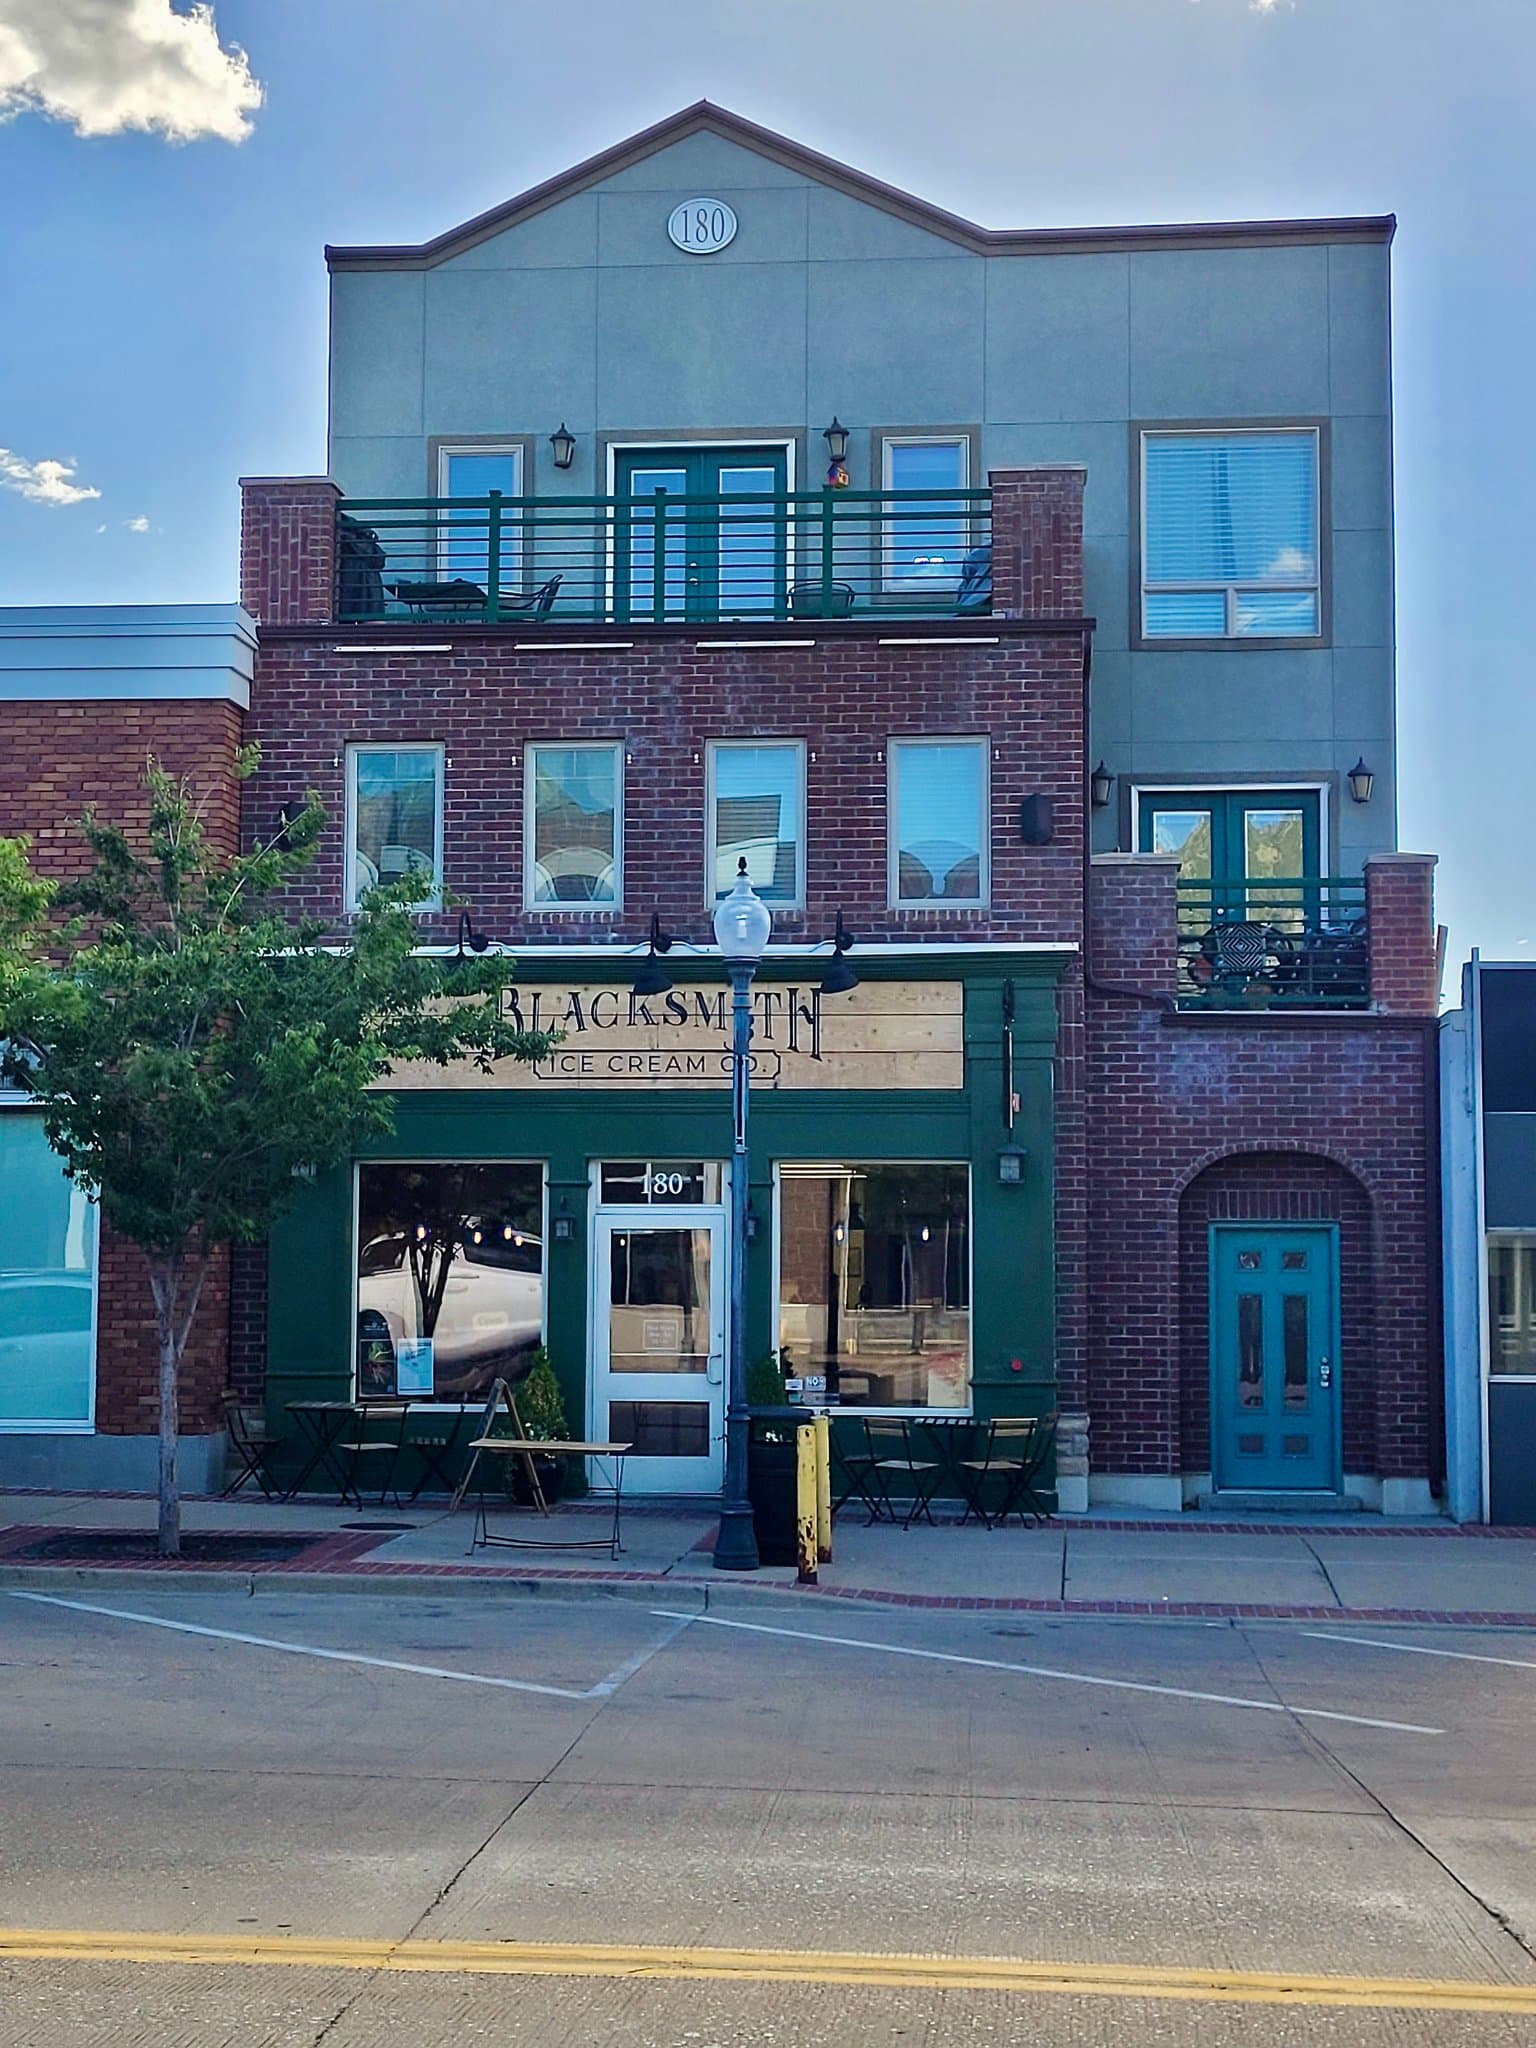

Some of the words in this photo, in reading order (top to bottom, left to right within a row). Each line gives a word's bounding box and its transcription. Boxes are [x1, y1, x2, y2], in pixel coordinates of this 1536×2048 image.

[682, 208, 725, 243] 180
[494, 986, 823, 1062] BLACKSMTH
[550, 1055, 594, 1073] ICE
[607, 1055, 705, 1073] CREAM
[640, 1172, 683, 1195] 180
